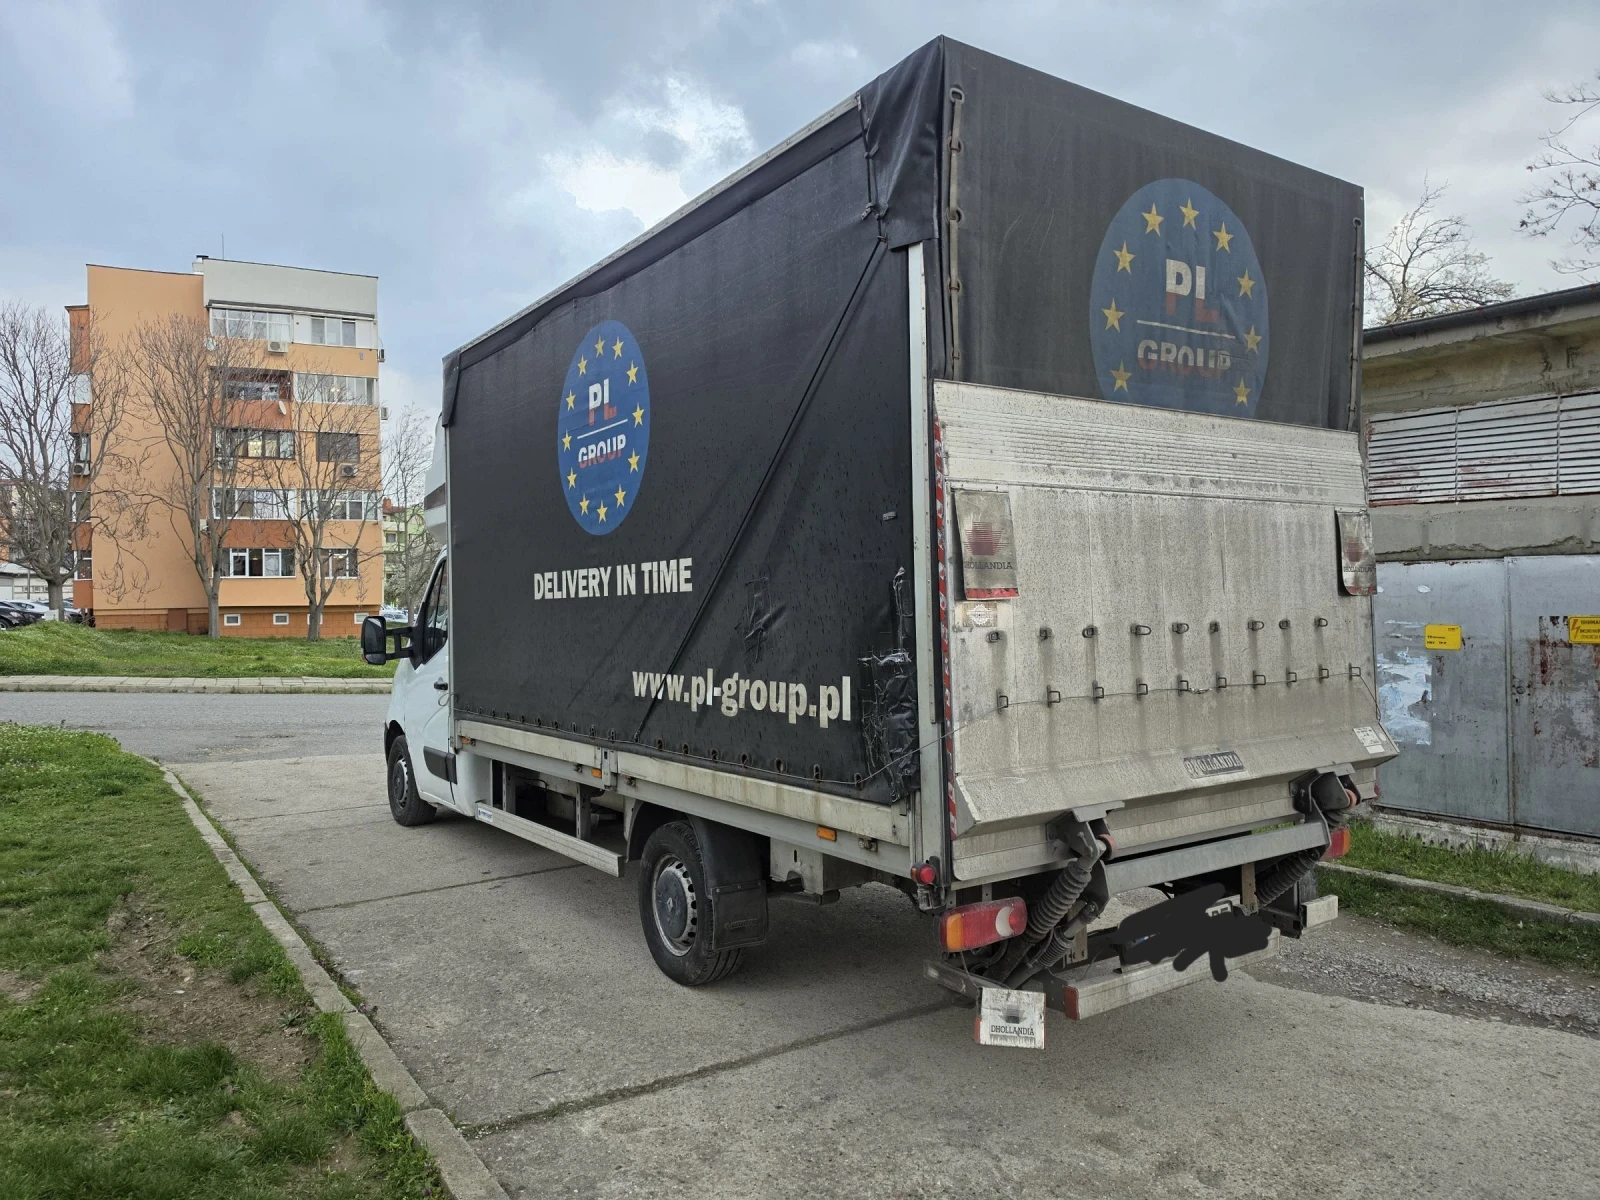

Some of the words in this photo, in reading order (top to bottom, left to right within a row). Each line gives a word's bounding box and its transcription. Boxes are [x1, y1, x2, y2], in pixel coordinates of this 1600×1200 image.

[1165, 258, 1219, 323] PL
[1137, 339, 1232, 378] GROUP
[588, 378, 617, 426] PL
[578, 433, 627, 469] GROUP
[534, 565, 612, 600] DELIVERY
[616, 563, 636, 596] IN
[641, 557, 693, 594] TIME
[632, 668, 851, 729] www.pl-group.pl
[990, 1024, 1035, 1036] DHOLLANDIA
